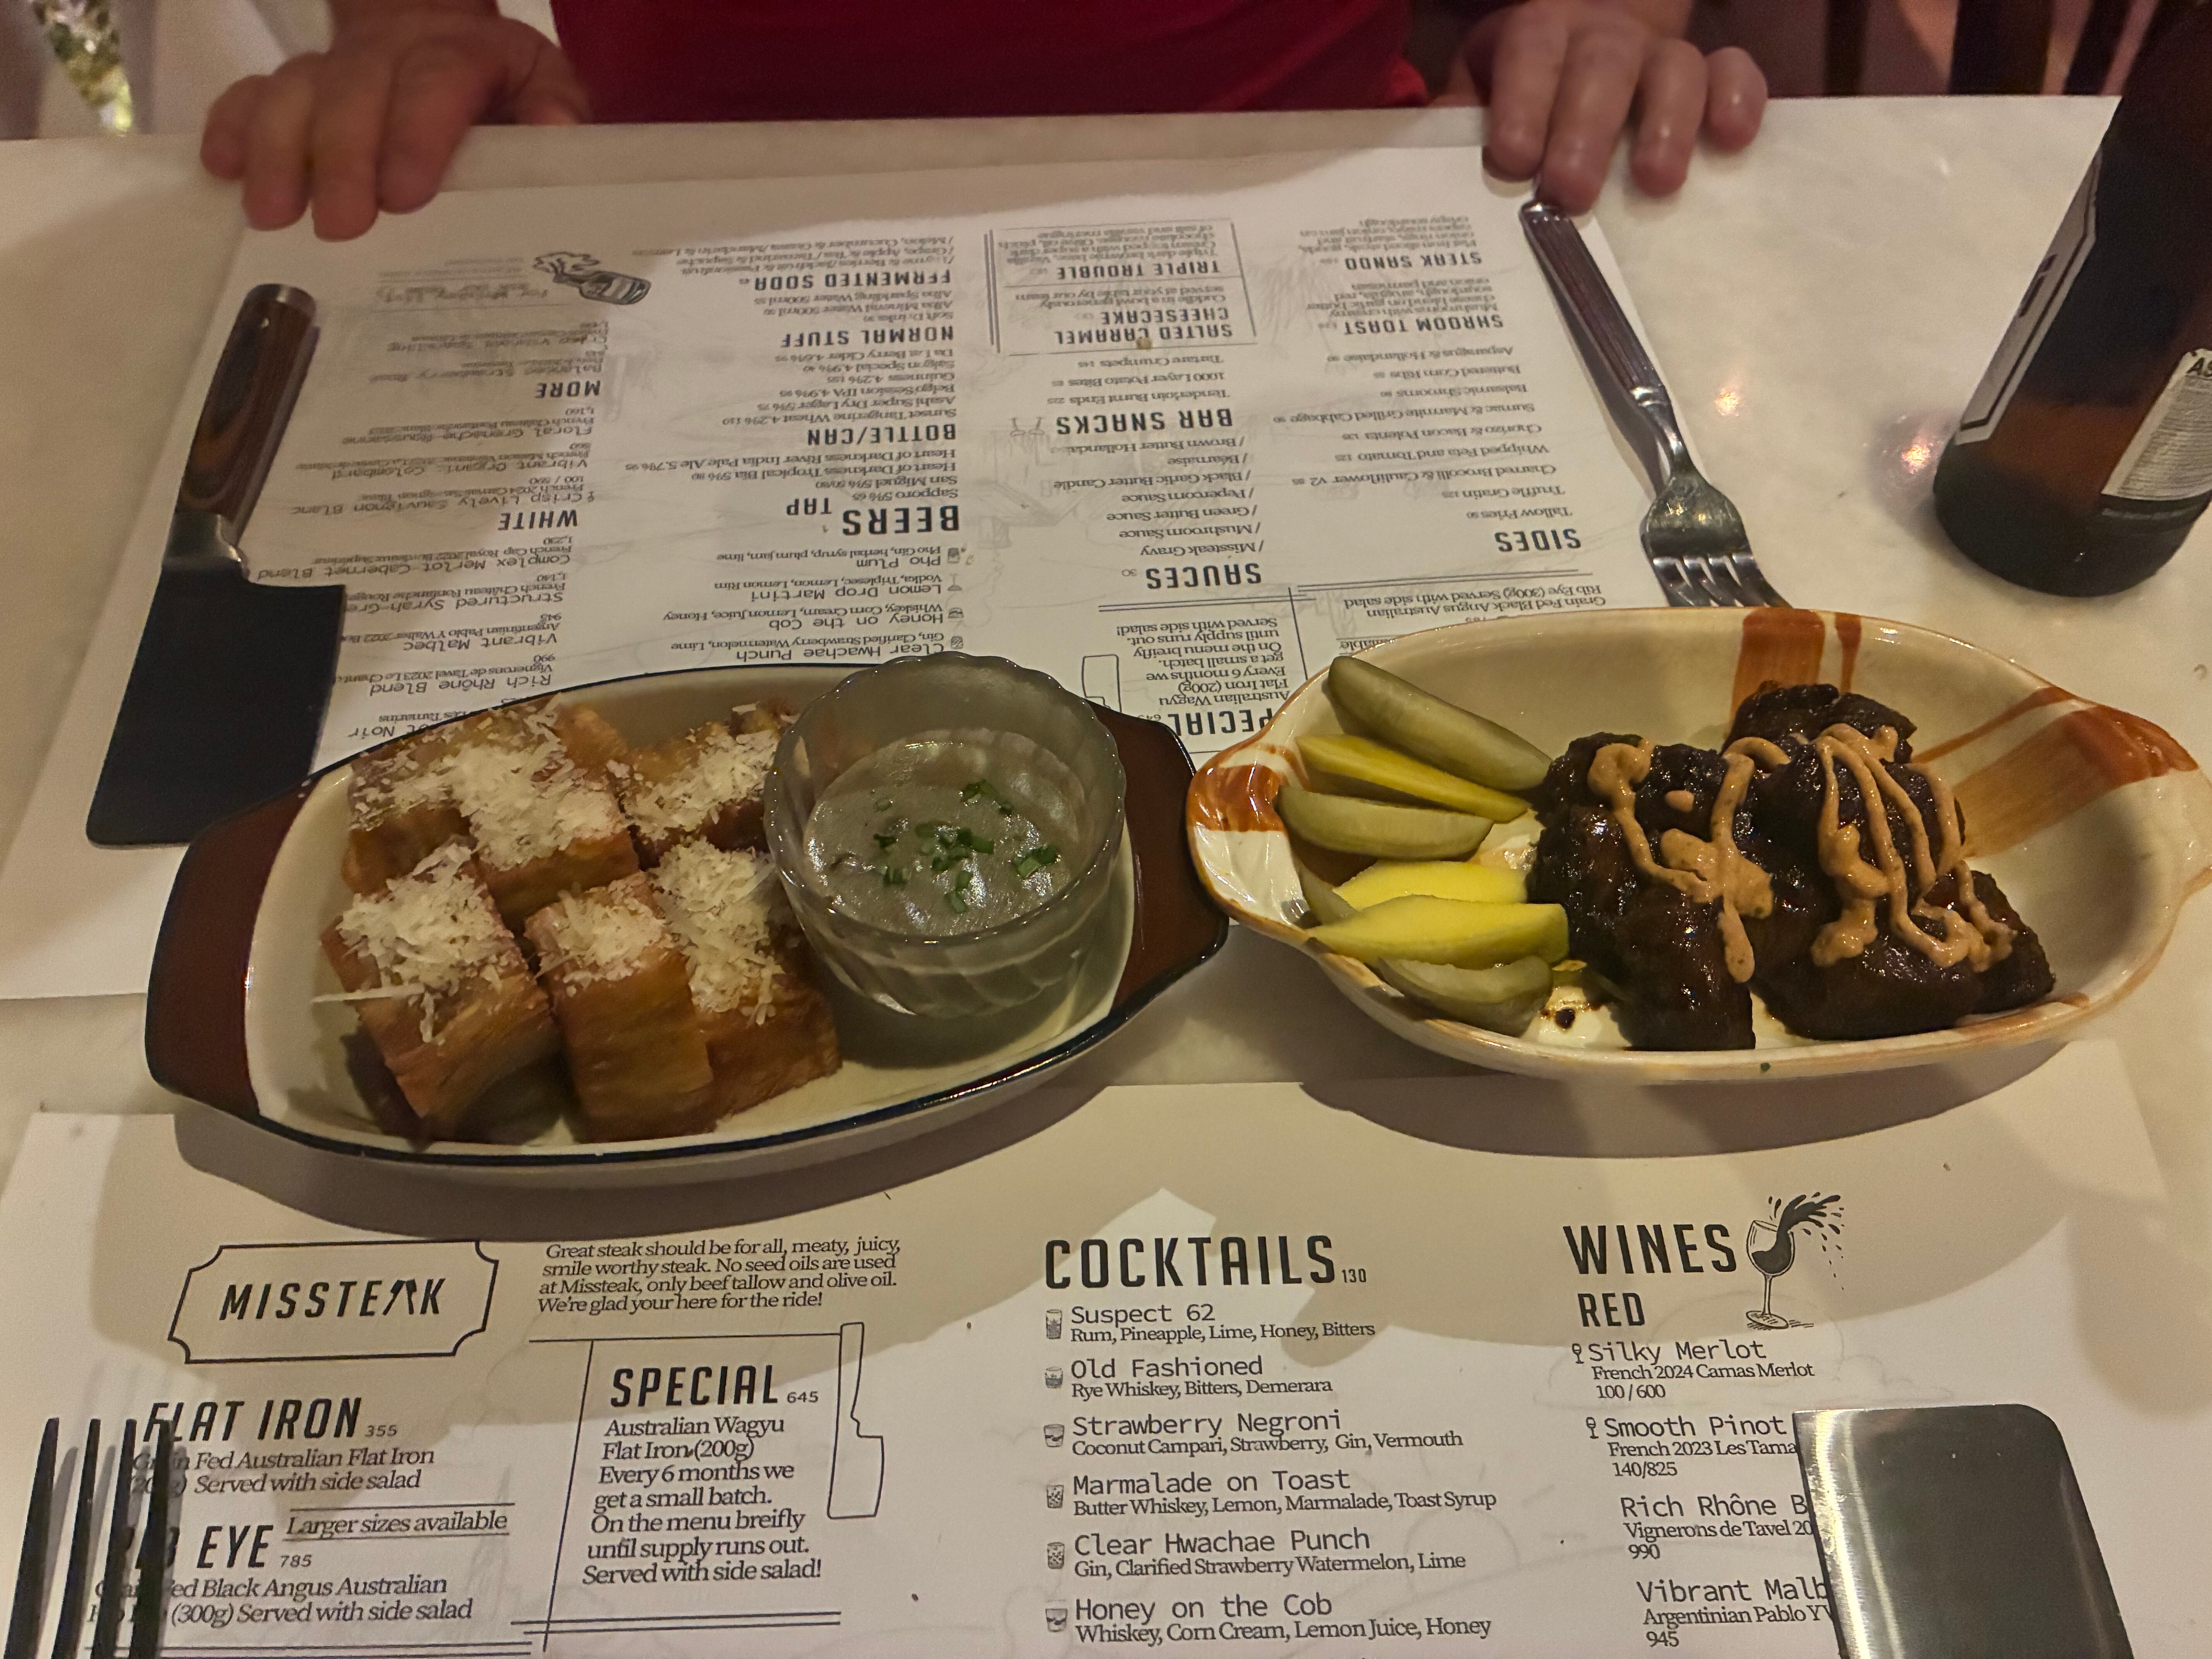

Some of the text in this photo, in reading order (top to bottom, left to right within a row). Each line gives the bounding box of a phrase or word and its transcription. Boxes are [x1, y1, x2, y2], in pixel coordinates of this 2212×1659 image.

[1420, 252, 1482, 267] STEAK
[1101, 307, 1229, 325] CHEESECAKE
[1345, 314, 1503, 335] SHROOM TOAST
[782, 326, 953, 348] NORMAL STUFF
[1159, 324, 1232, 340] SALTED
[535, 380, 601, 398] MORE
[1056, 408, 1233, 435] BAR SNACKS
[807, 424, 956, 446] BOTTLE/CAN
[929, 475, 957, 485] San
[1053, 472, 1243, 490] Black Garlic Butter Candle
[1310, 477, 1327, 486] v2
[787, 498, 832, 516] TAP
[1106, 507, 1250, 521] Green Butter Sauce
[1480, 507, 1573, 520] Tallow Fries
[498, 509, 578, 531] WHITE
[843, 505, 959, 536] BEERS
[1119, 524, 1252, 539] Mushroom Sauce
[1494, 528, 1582, 552] SIDES
[1140, 542, 1256, 556] Missteak Gravy
[857, 555, 941, 569] Pho Plum
[1146, 563, 1261, 589] SAUCES
[751, 584, 941, 602] Lemon Drop Martini
[1343, 597, 1382, 610] salad
[1384, 596, 1413, 606] side
[1416, 594, 1449, 605] with
[1451, 591, 1501, 603] Served
[1366, 596, 1606, 619] Grain Fed Black Angus Australian
[769, 612, 943, 631] Honey on the Cob
[404, 633, 557, 652] Vibrant Malbec
[1184, 645, 1230, 654] menu
[1232, 643, 1256, 654] the
[1258, 642, 1282, 654] On
[530, 654, 555, 667] 990
[369, 674, 551, 697] Rich Rhône Blend
[1159, 690, 1289, 706] Australian Wagyu
[1167, 708, 1272, 736] PECIAL
[546, 1236, 900, 1259] Great steak should be for all, meaty, juicy,
[1563, 1224, 1736, 1275] WINES
[1045, 1235, 1366, 1289] COCKTAILS 130
[538, 1290, 823, 1316] We're glad your here for the ride!
[1578, 1293, 1645, 1327] RED
[1071, 1303, 1215, 1327] Suspect 62
[1070, 1321, 1376, 1345] Rum, Pineapple, Lime, Honey, Bitters
[1588, 1339, 1767, 1366] Silky Merlot
[1071, 1354, 1262, 1379] Old Fashioned
[1591, 1361, 1815, 1380] French 2024 Camas Merlot
[610, 1365, 818, 1407] SPECIAL 645
[1596, 1384, 1625, 1399] 100
[1636, 1384, 1666, 1399] 600
[257, 1397, 362, 1441] IRON
[365, 1425, 397, 1437] 355
[604, 1416, 785, 1439] Australian Wagyu
[1073, 1409, 1340, 1438] Strawberry Negroni
[1604, 1415, 1787, 1437] Smooth Pinot
[602, 1439, 755, 1463] Flat Iron (200g)
[598, 1462, 795, 1489] Every 6 months we
[1612, 1461, 1678, 1479] 140/825
[1074, 1469, 1351, 1496] Marmalade on Toast
[1620, 1493, 1777, 1517] Rich Rhône
[286, 1511, 508, 1539] Larger sizes available
[1075, 1527, 1370, 1556] Clear Hwachae Punch
[1628, 1544, 1661, 1560] 990
[1636, 1577, 1830, 1602] Vibrant Malb
[1646, 1630, 1679, 1647] 945
